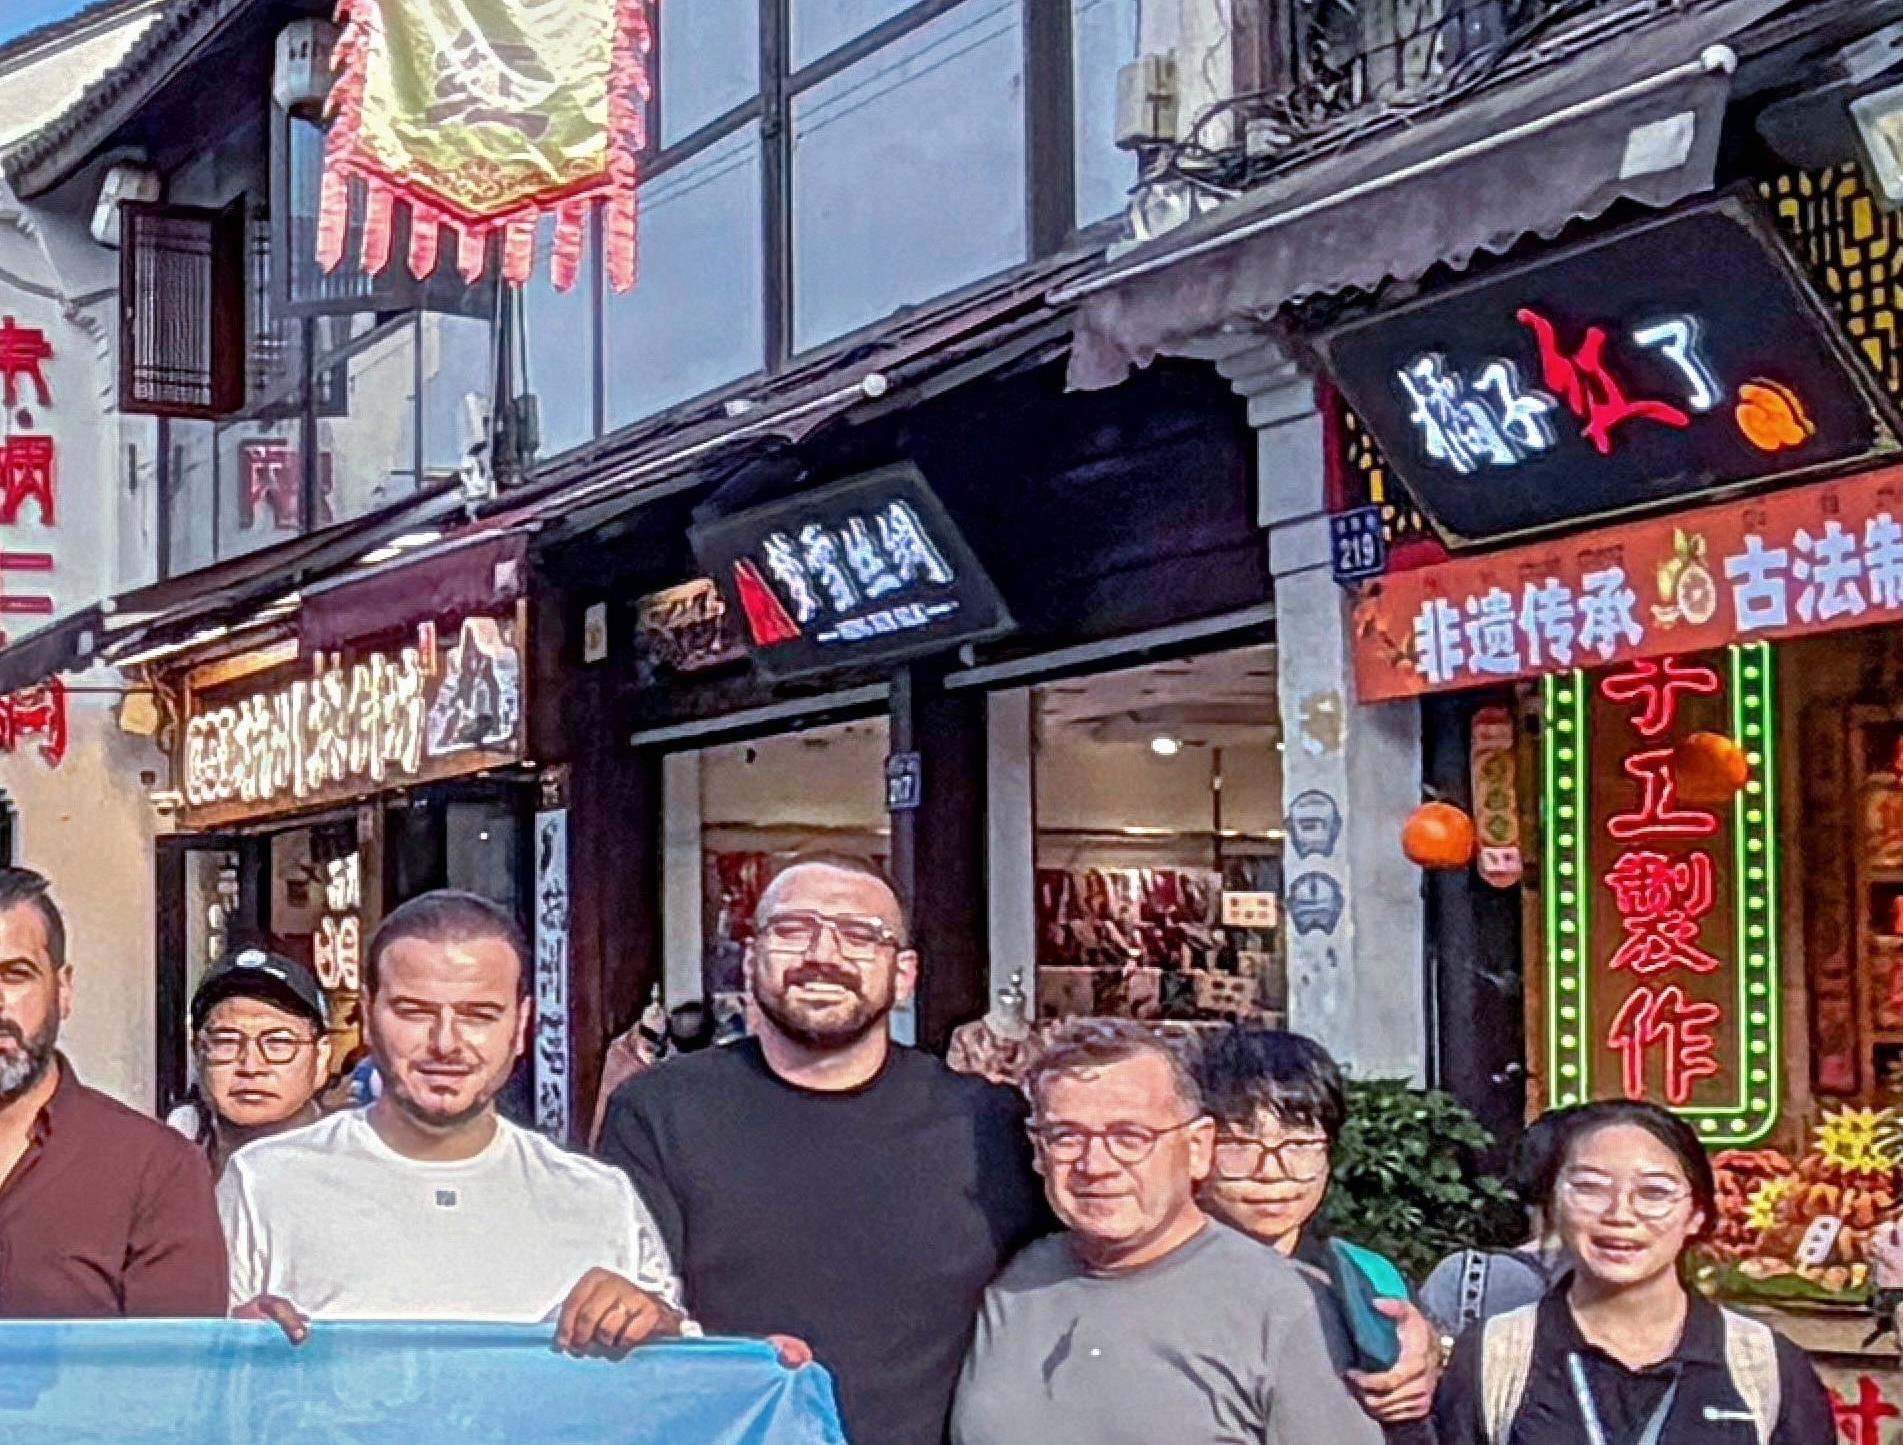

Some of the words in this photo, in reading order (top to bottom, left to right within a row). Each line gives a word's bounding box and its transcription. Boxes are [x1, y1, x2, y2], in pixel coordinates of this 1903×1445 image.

[1340, 534, 1377, 570] 219
[1414, 566, 1644, 683] 非遗传承
